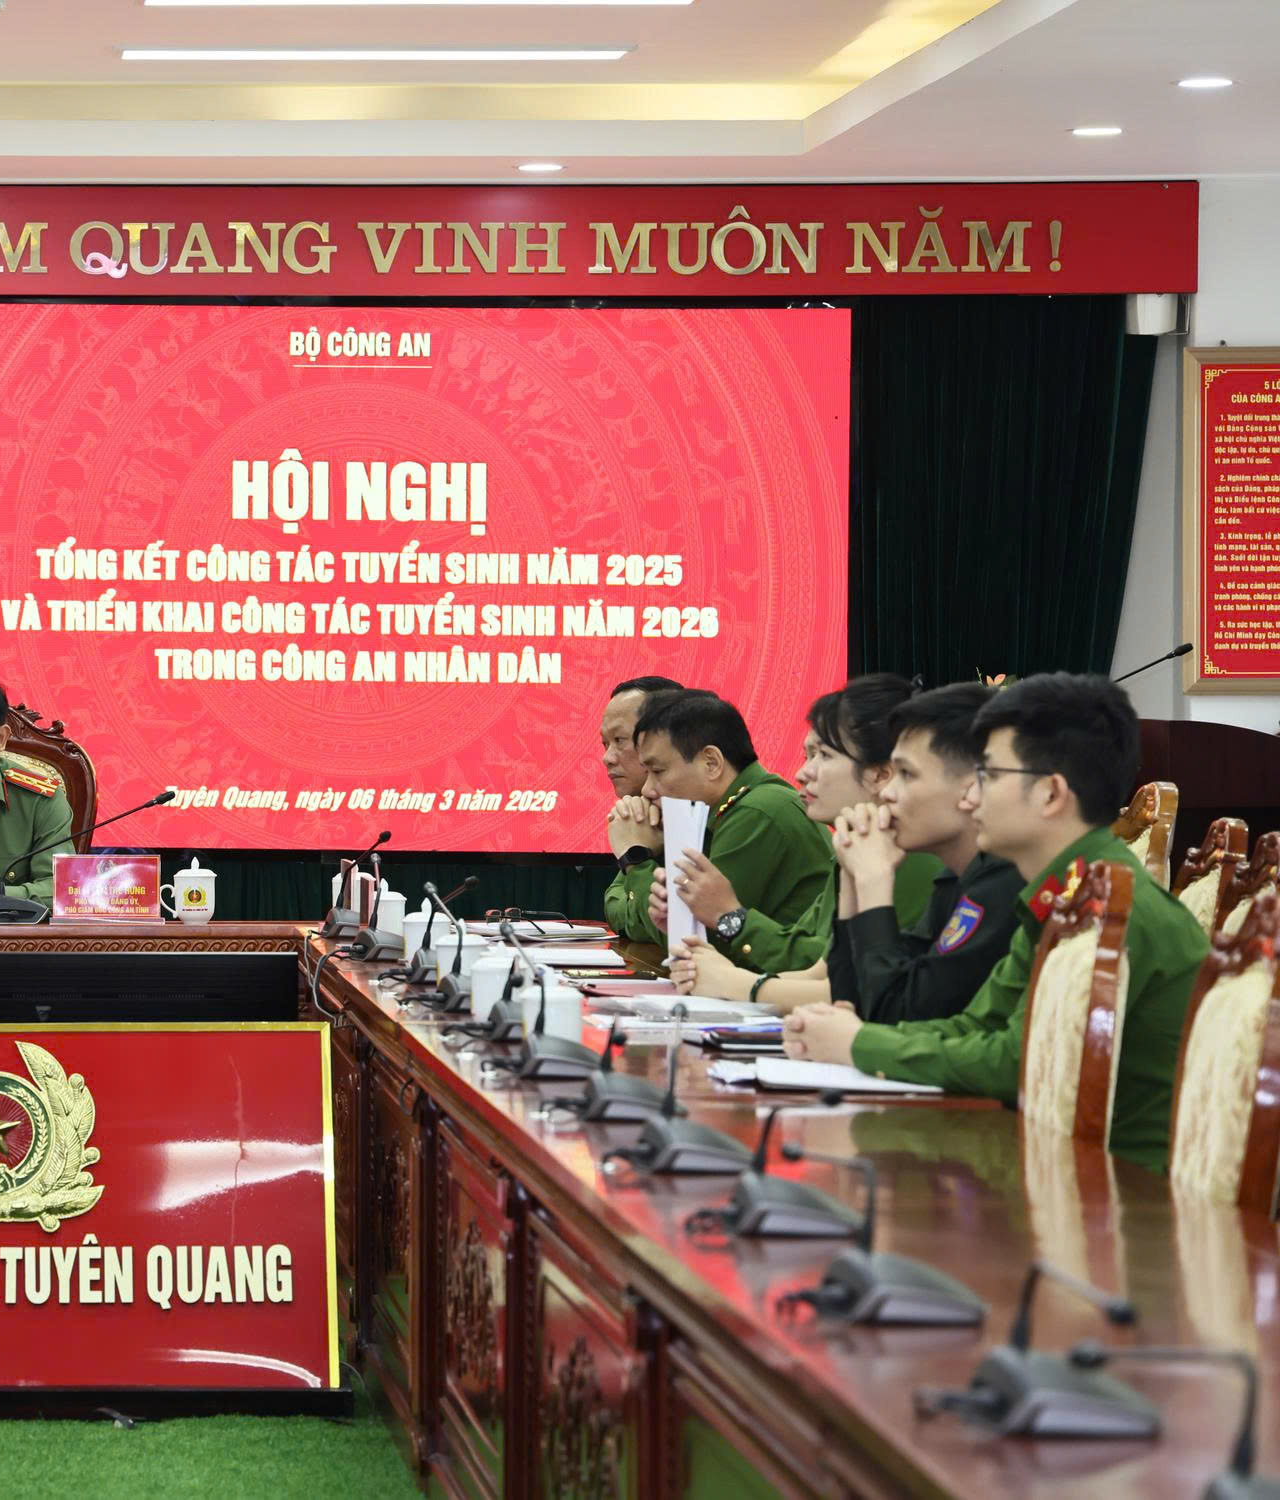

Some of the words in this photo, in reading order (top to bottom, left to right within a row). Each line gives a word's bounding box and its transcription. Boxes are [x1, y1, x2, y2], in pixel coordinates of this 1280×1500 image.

[68, 220, 338, 279] QUANG
[357, 221, 566, 274] VINH
[587, 204, 824, 276] MUÔN
[845, 205, 1033, 273] NĂM
[290, 327, 320, 361] BỘ
[327, 327, 390, 357] CÔNG
[398, 332, 431, 357] AN
[1231, 392, 1248, 403] CỦA
[1250, 392, 1273, 403] CÔNG
[231, 448, 329, 534] HỘI
[345, 461, 487, 536] NGHỊ
[36, 536, 117, 580] TỔNG
[123, 540, 180, 581] KẾT
[187, 544, 270, 582] CÔNG
[276, 545, 334, 582] TÁC
[342, 540, 440, 583] TUYỂN
[445, 552, 519, 584] SINH
[527, 547, 598, 585] NĂM
[606, 555, 683, 586] 2025
[1, 593, 42, 631] VÀ
[47, 588, 136, 632] TRIỂN
[143, 601, 214, 633] KHAI
[221, 596, 305, 634] CÔNG
[312, 597, 370, 635] TÁC
[377, 592, 475, 635] TUYỂN
[481, 604, 555, 636] SINH
[563, 599, 634, 637] NĂM
[642, 607, 719, 638] 2026
[155, 648, 256, 680] TRONG
[262, 643, 345, 682] CÔNG
[352, 651, 396, 682] AN
[404, 645, 490, 683] NHÂN
[498, 646, 561, 684] DÂN
[222, 786, 289, 811] Quang,
[295, 788, 346, 812] ngày
[347, 788, 373, 810] 06
[379, 788, 435, 813] tháng
[438, 789, 452, 810] 3
[455, 788, 500, 811] năm
[504, 790, 558, 812] 2026
[0, 1234, 133, 1305] TUYÊN
[146, 1244, 293, 1310] QUANG
